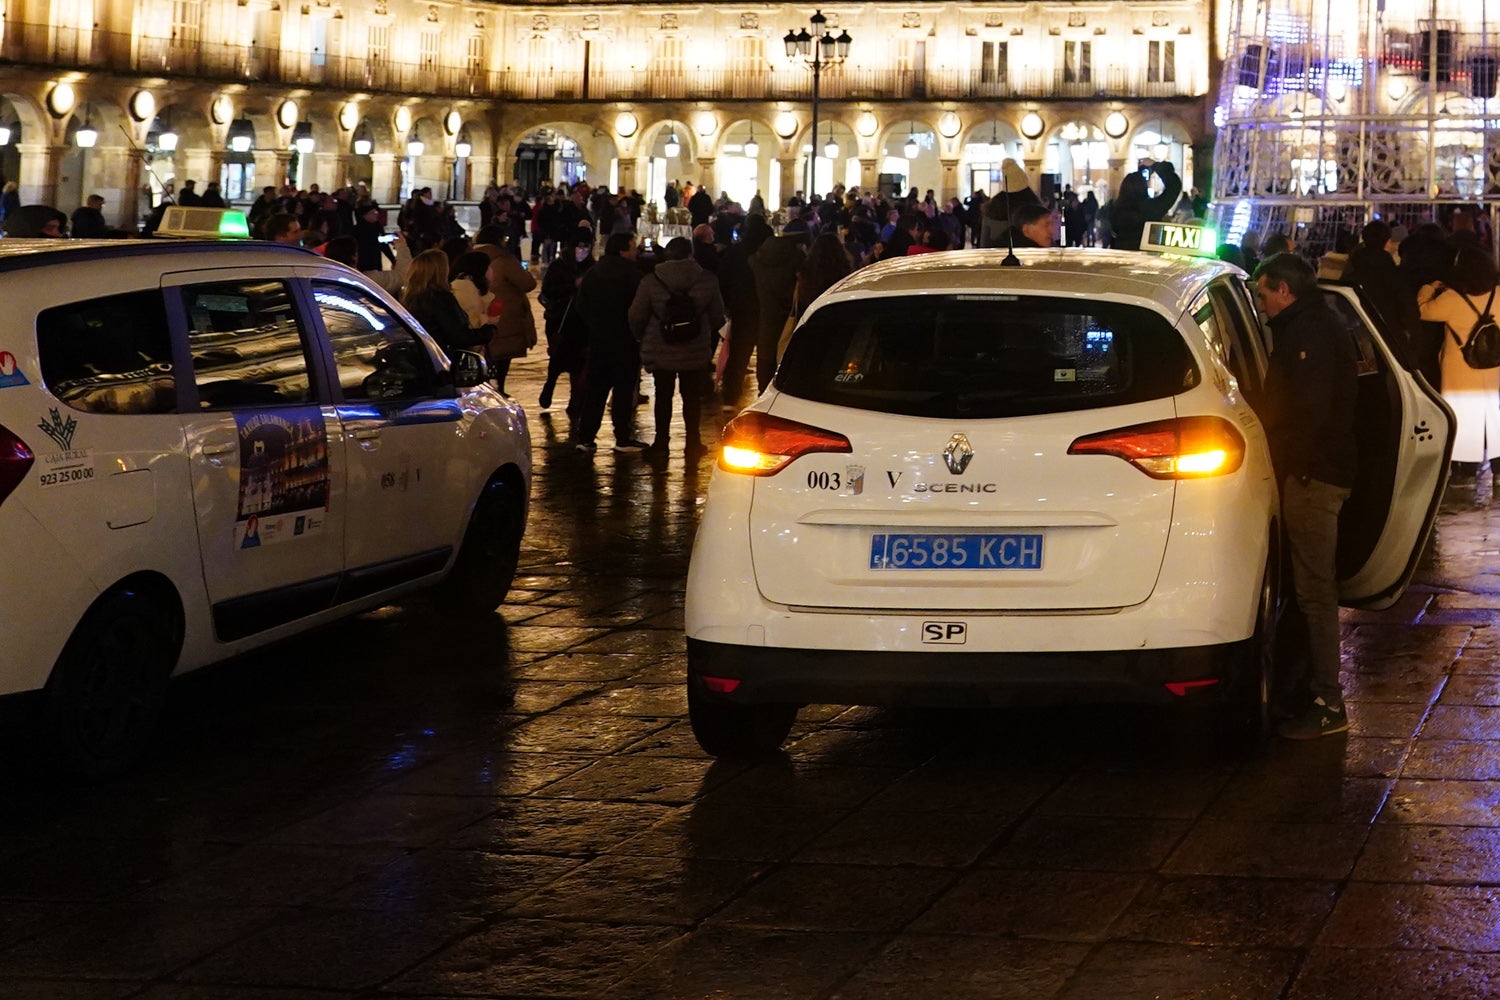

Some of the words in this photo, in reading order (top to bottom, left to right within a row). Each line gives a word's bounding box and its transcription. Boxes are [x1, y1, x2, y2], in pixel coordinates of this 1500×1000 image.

[1163, 225, 1201, 249] TAXI
[40, 473, 58, 486] 923
[59, 470, 70, 482] 25
[71, 469, 82, 481] 00
[83, 467, 94, 479] 00
[807, 471, 841, 491] 003
[886, 470, 903, 489] V
[914, 483, 997, 493] SCENIC
[891, 537, 968, 566] 6585
[978, 537, 1038, 566] KCH
[925, 624, 965, 640] SP
